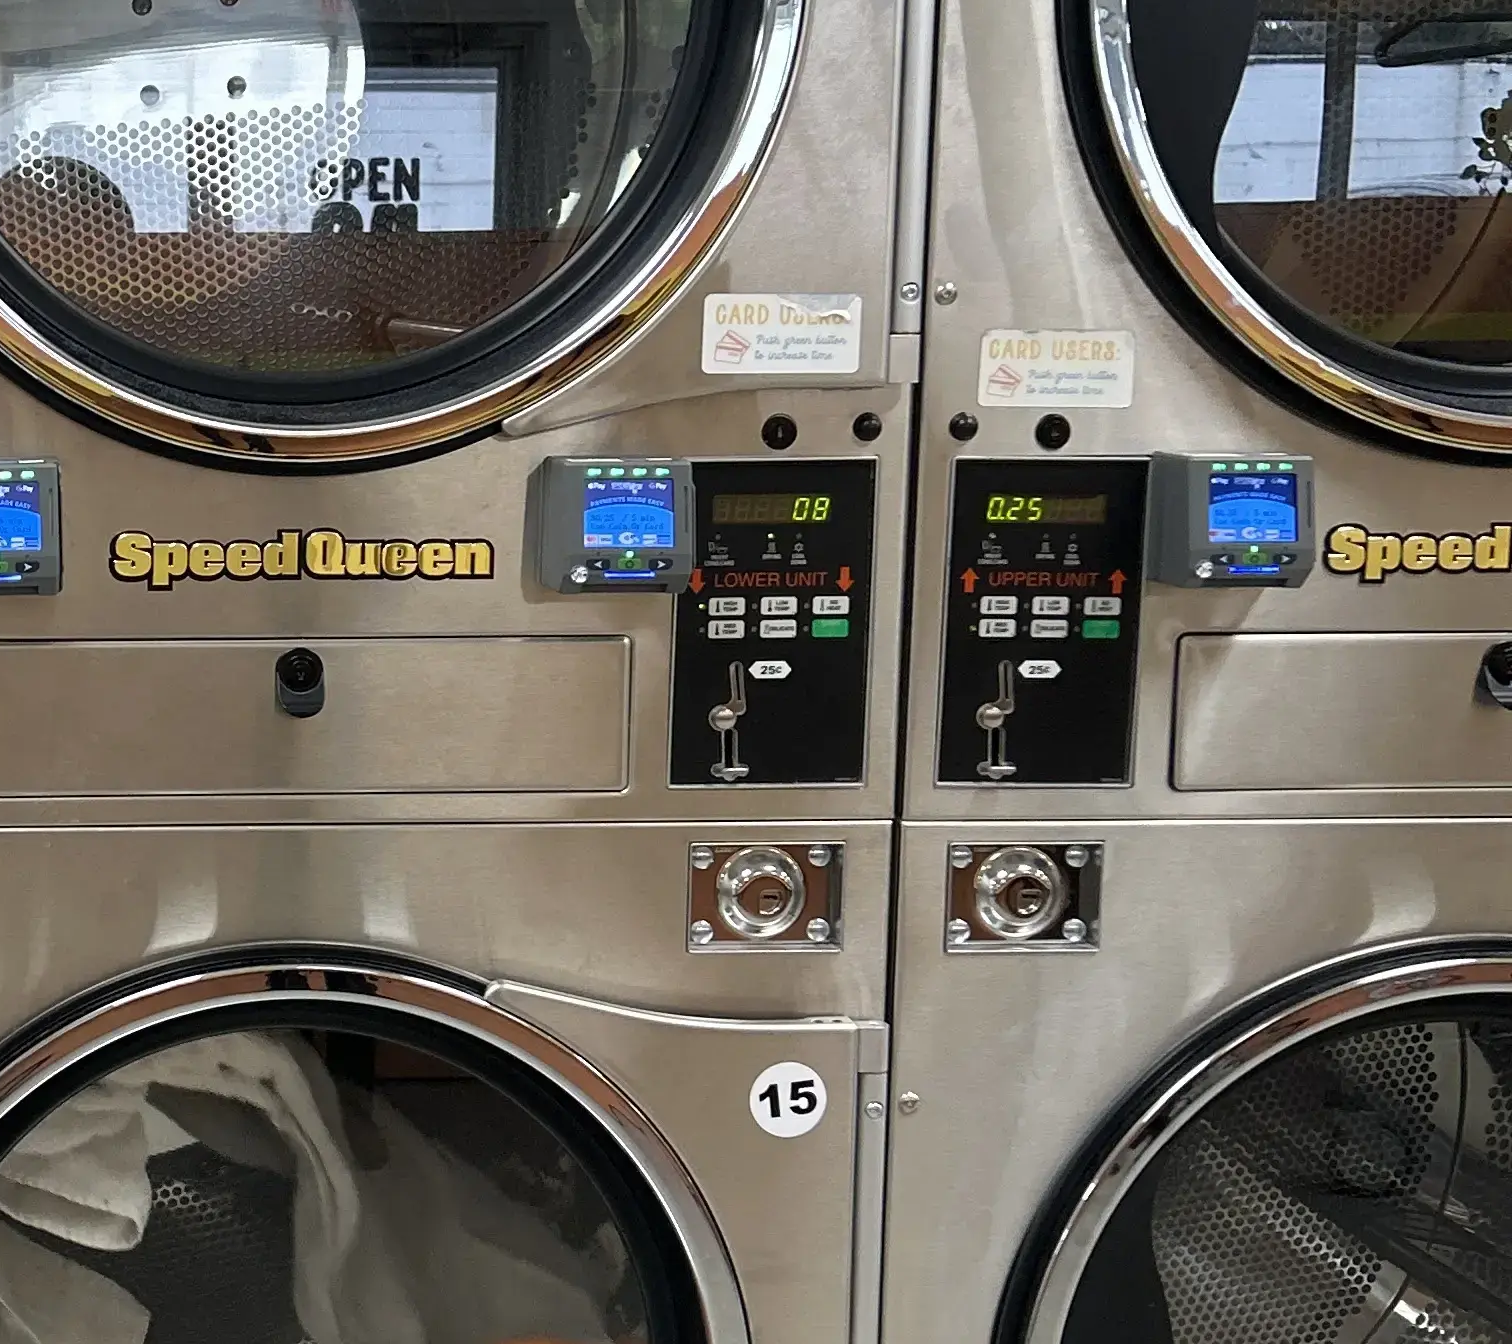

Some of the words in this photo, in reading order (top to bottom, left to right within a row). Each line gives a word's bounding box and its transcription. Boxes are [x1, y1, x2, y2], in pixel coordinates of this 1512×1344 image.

[715, 303, 770, 325] CARD
[756, 334, 780, 345] Push
[783, 336, 812, 349] green
[989, 339, 1041, 359] CARD
[1052, 340, 1121, 361] USERS:
[792, 497, 830, 521] 08
[986, 497, 1043, 521] 0.25
[108, 529, 302, 592] Speed
[302, 528, 494, 581] Queen
[1324, 522, 1512, 584] Speed
[714, 572, 781, 588] LOWER
[786, 572, 829, 588] UNIT
[989, 572, 1051, 587] UPPER
[1056, 572, 1101, 587] UNIT
[759, 1079, 817, 1118] 15
